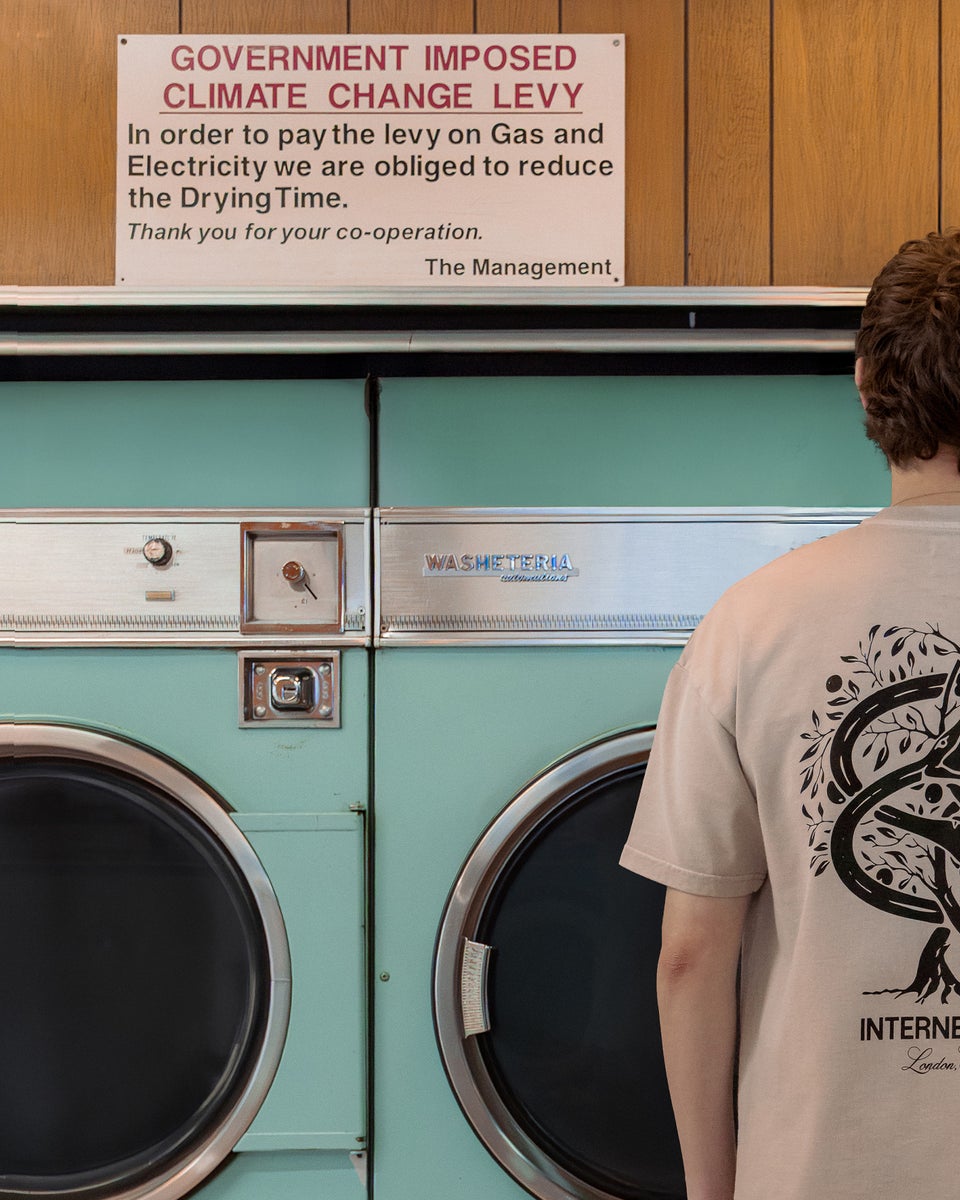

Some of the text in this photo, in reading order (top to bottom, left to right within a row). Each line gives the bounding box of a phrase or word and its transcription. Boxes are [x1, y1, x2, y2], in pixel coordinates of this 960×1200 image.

[171, 44, 577, 72] GOVERNMENT IMPOSED
[163, 82, 584, 109] CLIMATE CHANGE LEVY
[128, 122, 604, 151] In order to pay the levy on Gas and
[128, 154, 614, 183] Electricity we are obliged to reduce
[128, 186, 348, 215] the Drying Time.
[128, 222, 483, 245] Thank you for your co-operation.
[425, 258, 612, 280] The Management
[425, 553, 574, 572] WASHETERIA
